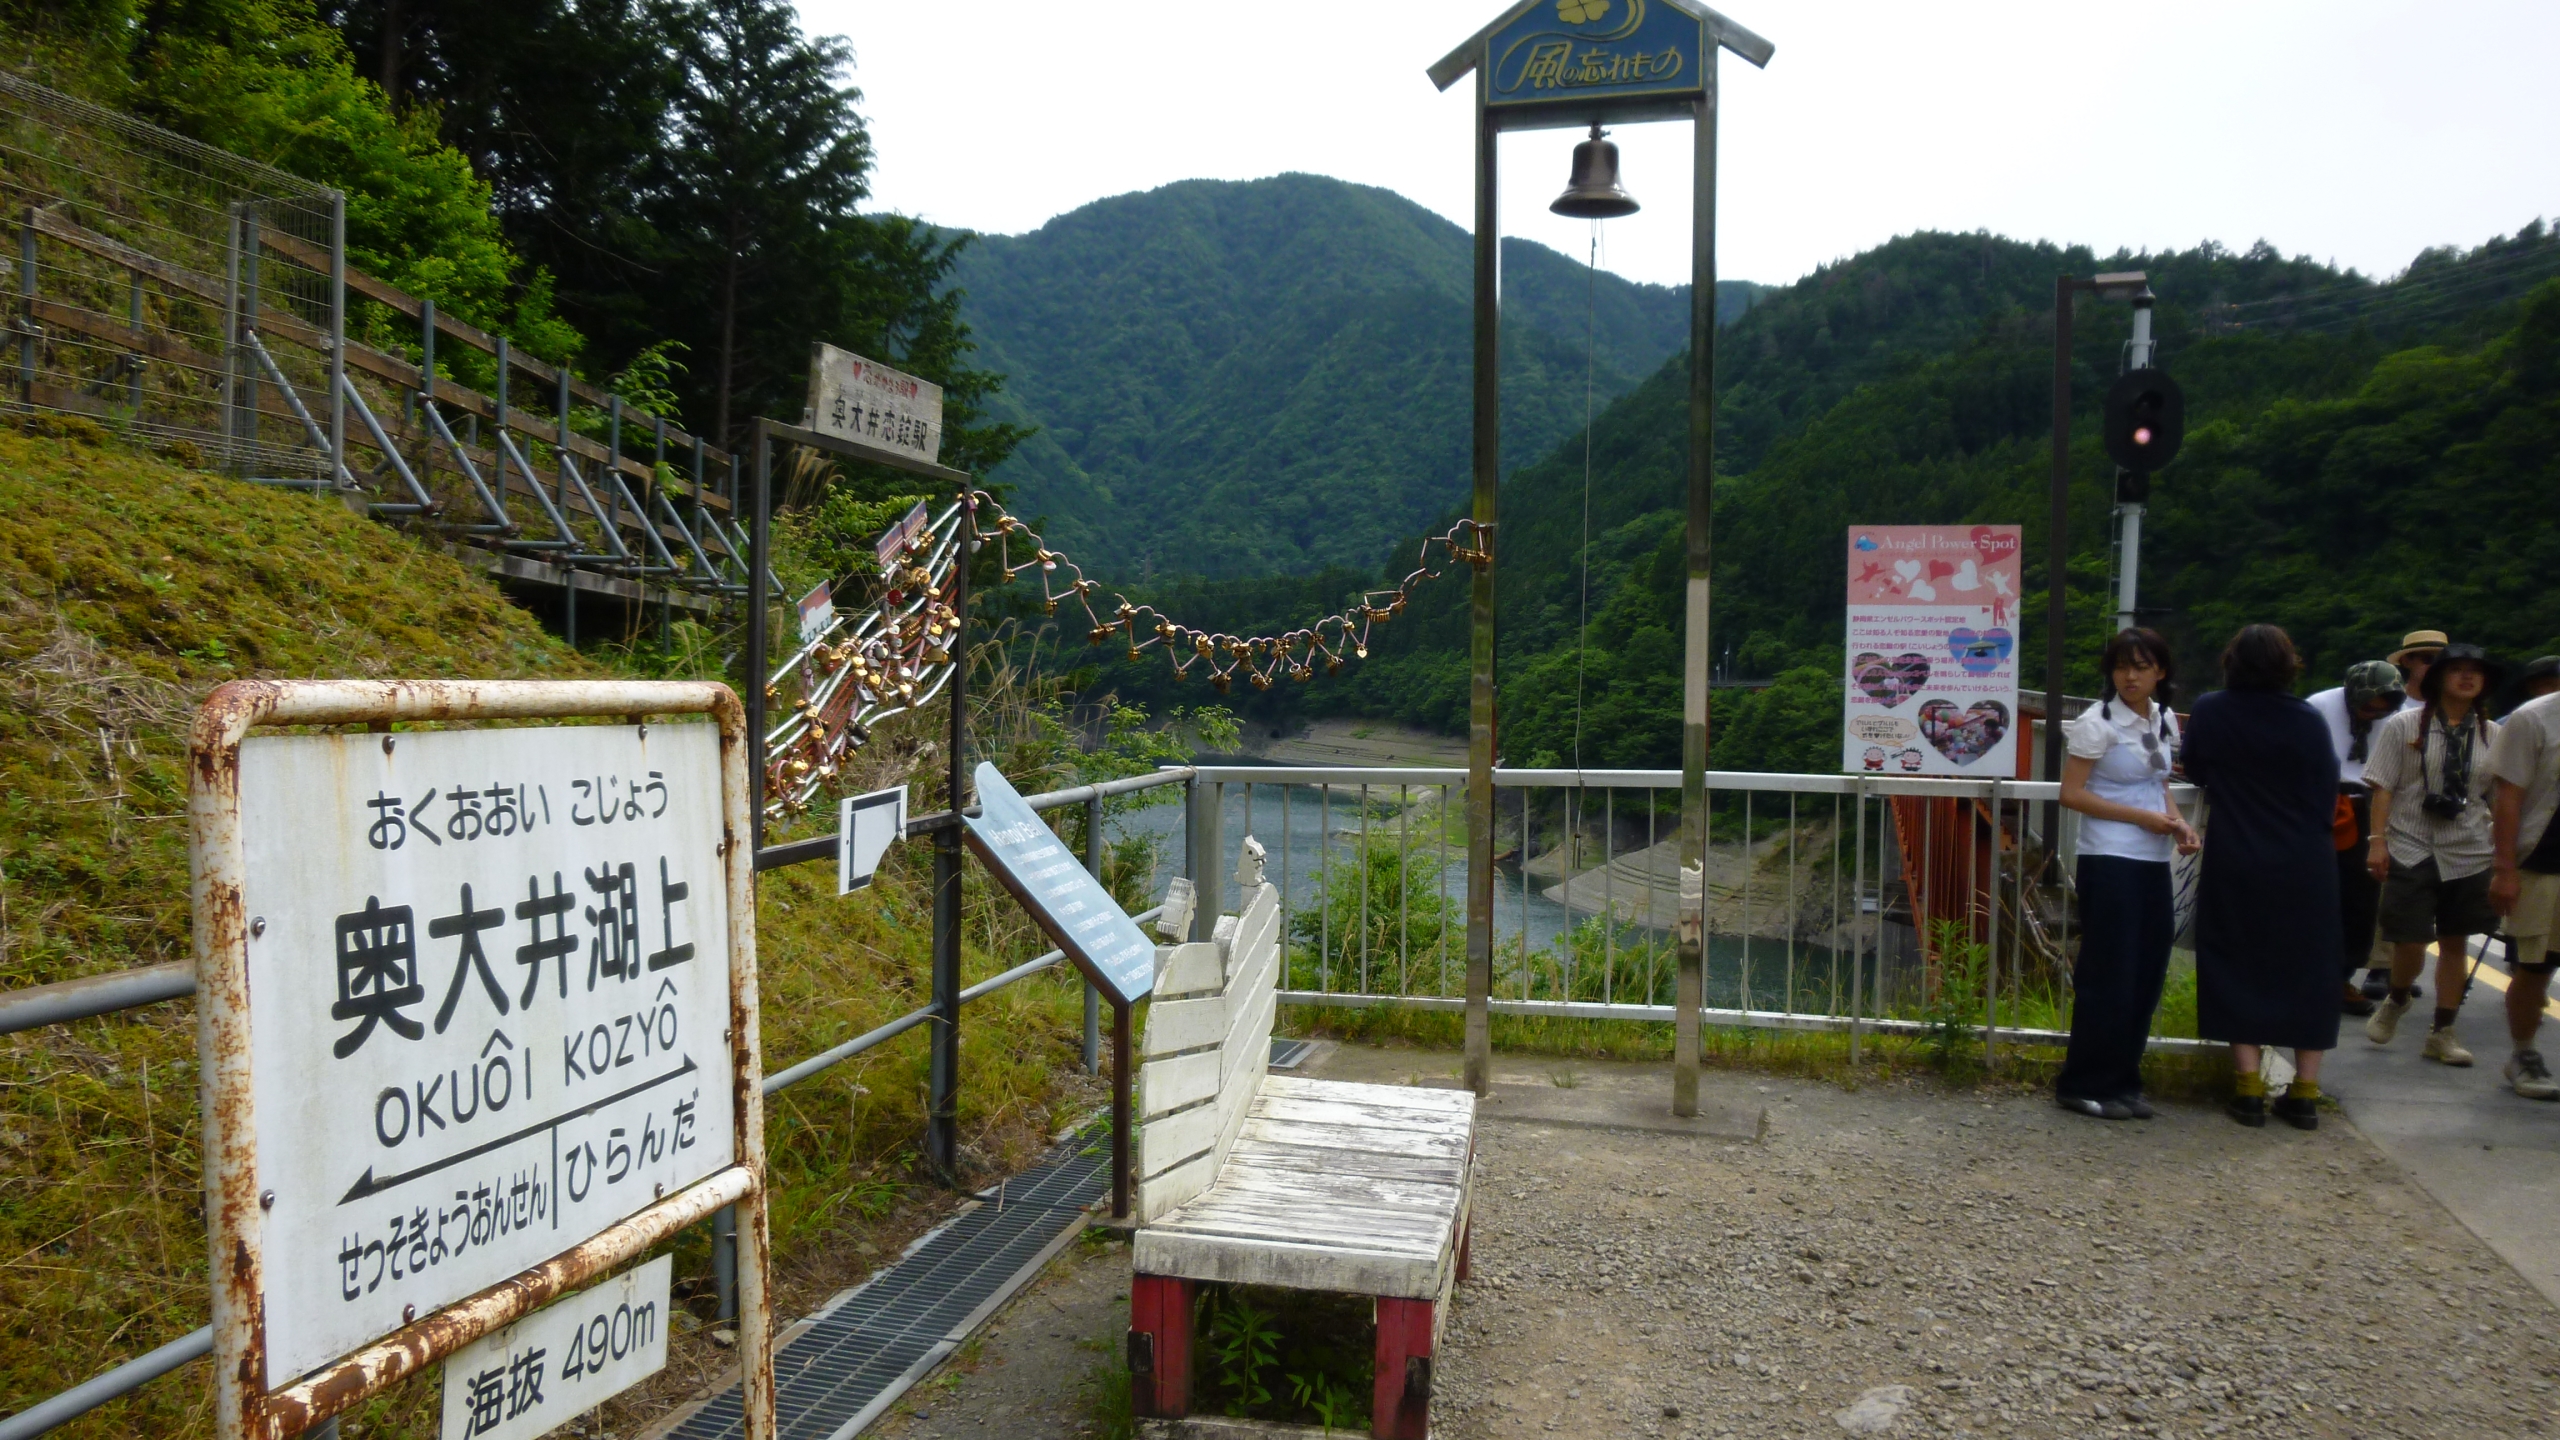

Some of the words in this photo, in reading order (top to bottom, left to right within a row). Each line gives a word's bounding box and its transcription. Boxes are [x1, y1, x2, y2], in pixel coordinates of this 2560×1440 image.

[1498, 41, 1683, 92] 風の忘れもの
[832, 395, 928, 451] 奥大井恋錠駅
[1880, 533, 1926, 551] Angel
[1931, 534, 1977, 549] Power
[1980, 534, 2016, 553] Spot
[367, 780, 551, 850] おくおおい
[571, 770, 668, 826] こじょう
[1018, 818, 1045, 839] Bell
[331, 855, 695, 1059] 奥大井湖上
[563, 976, 678, 1087] KOZYÔ
[565, 1087, 699, 1203] ひらんだ
[464, 1345, 547, 1440] 海抜
[561, 1300, 656, 1383] 490m
